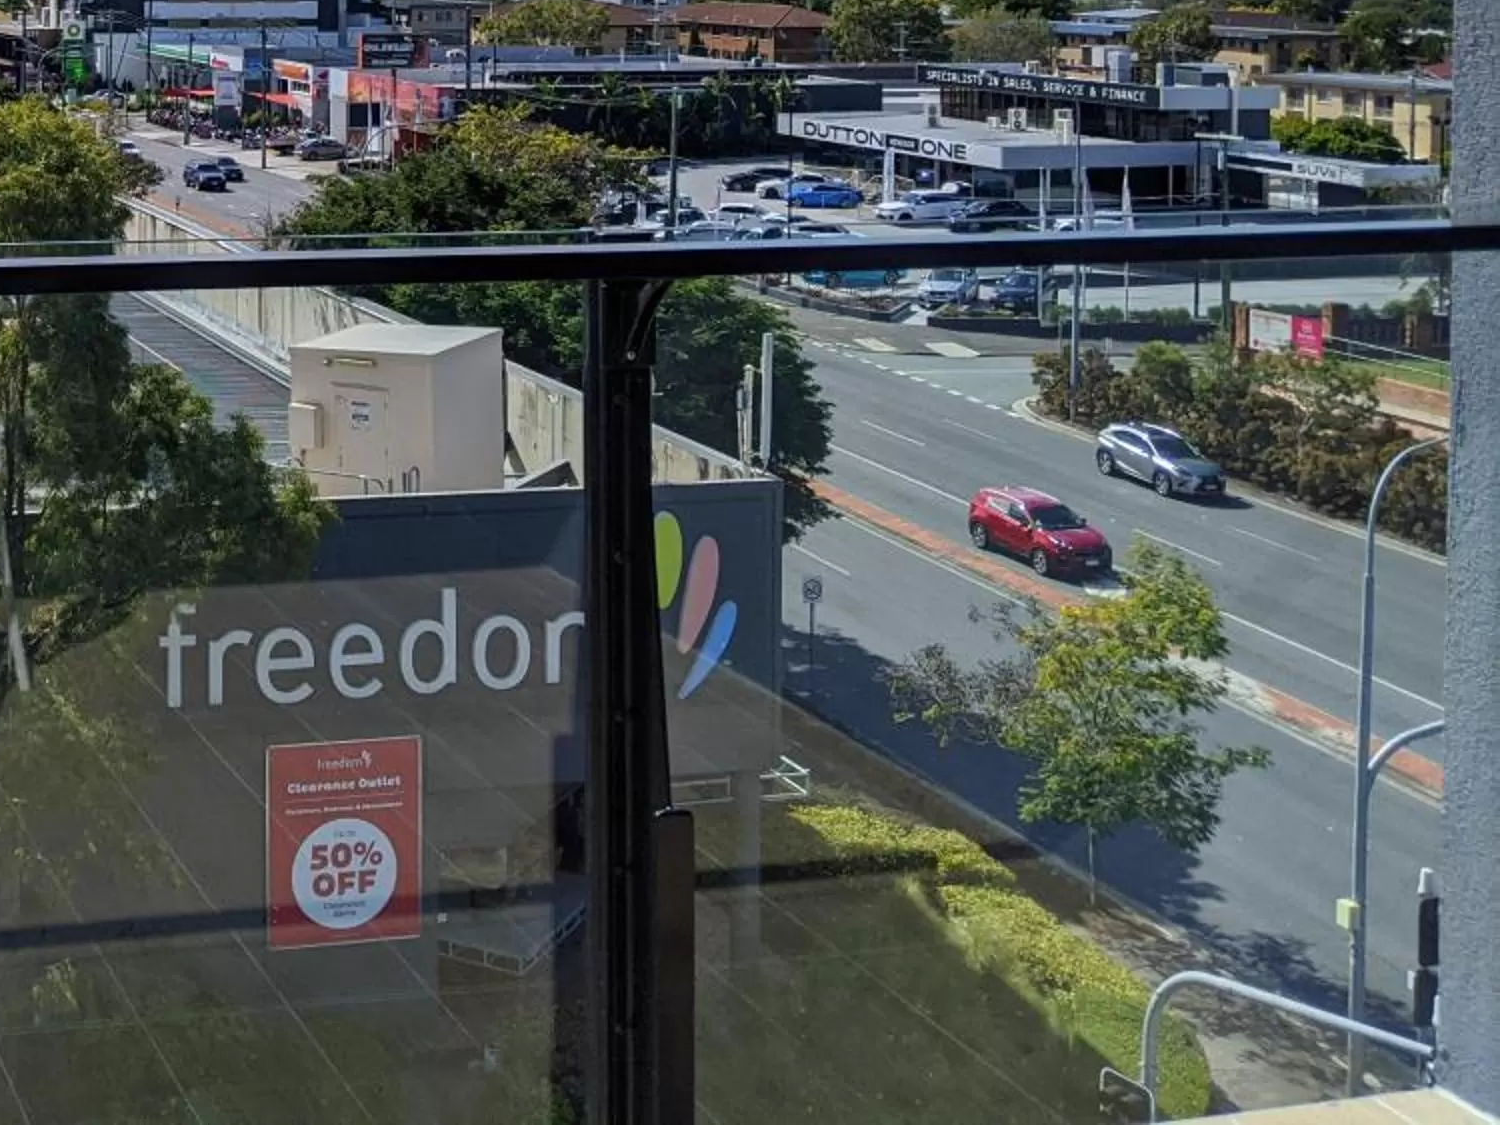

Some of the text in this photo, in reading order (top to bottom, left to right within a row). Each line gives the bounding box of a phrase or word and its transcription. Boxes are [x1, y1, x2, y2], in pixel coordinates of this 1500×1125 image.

[926, 69, 984, 87] SPECIALISTS
[986, 75, 1000, 87] IN
[1101, 87, 1147, 103] FINANCE
[803, 120, 885, 148] DUTTON
[920, 138, 968, 161] ONE
[287, 775, 402, 795] Clearance Outlet
[310, 840, 383, 871] 50%
[311, 869, 377, 897] OFF
